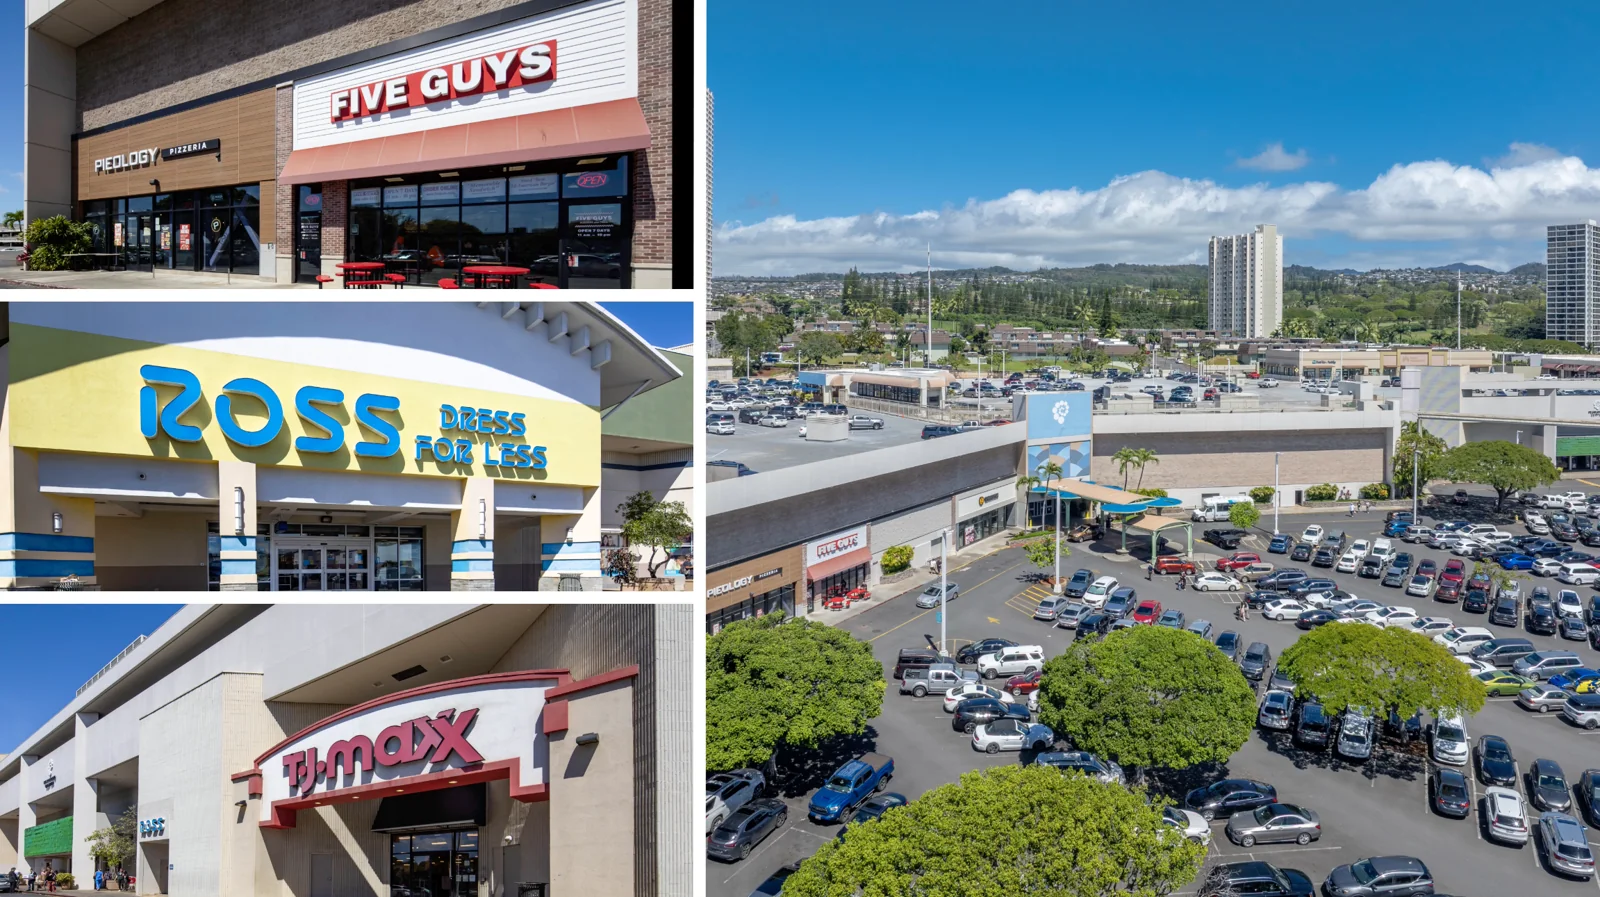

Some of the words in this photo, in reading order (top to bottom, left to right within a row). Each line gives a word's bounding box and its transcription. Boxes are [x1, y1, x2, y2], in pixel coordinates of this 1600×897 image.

[331, 77, 407, 118] FIVE
[420, 43, 552, 99] GUYS
[94, 147, 159, 172] PIEOLOGY
[169, 142, 207, 155] PIZZERIA
[577, 174, 607, 186] OPEN
[139, 364, 401, 459] ROSS
[440, 403, 527, 437] DRESS
[415, 434, 474, 465] FOR
[484, 441, 548, 469] LESS
[818, 541, 837, 556] FIVE
[837, 535, 859, 550] GUYS
[706, 574, 754, 599] PIEOLOGY
